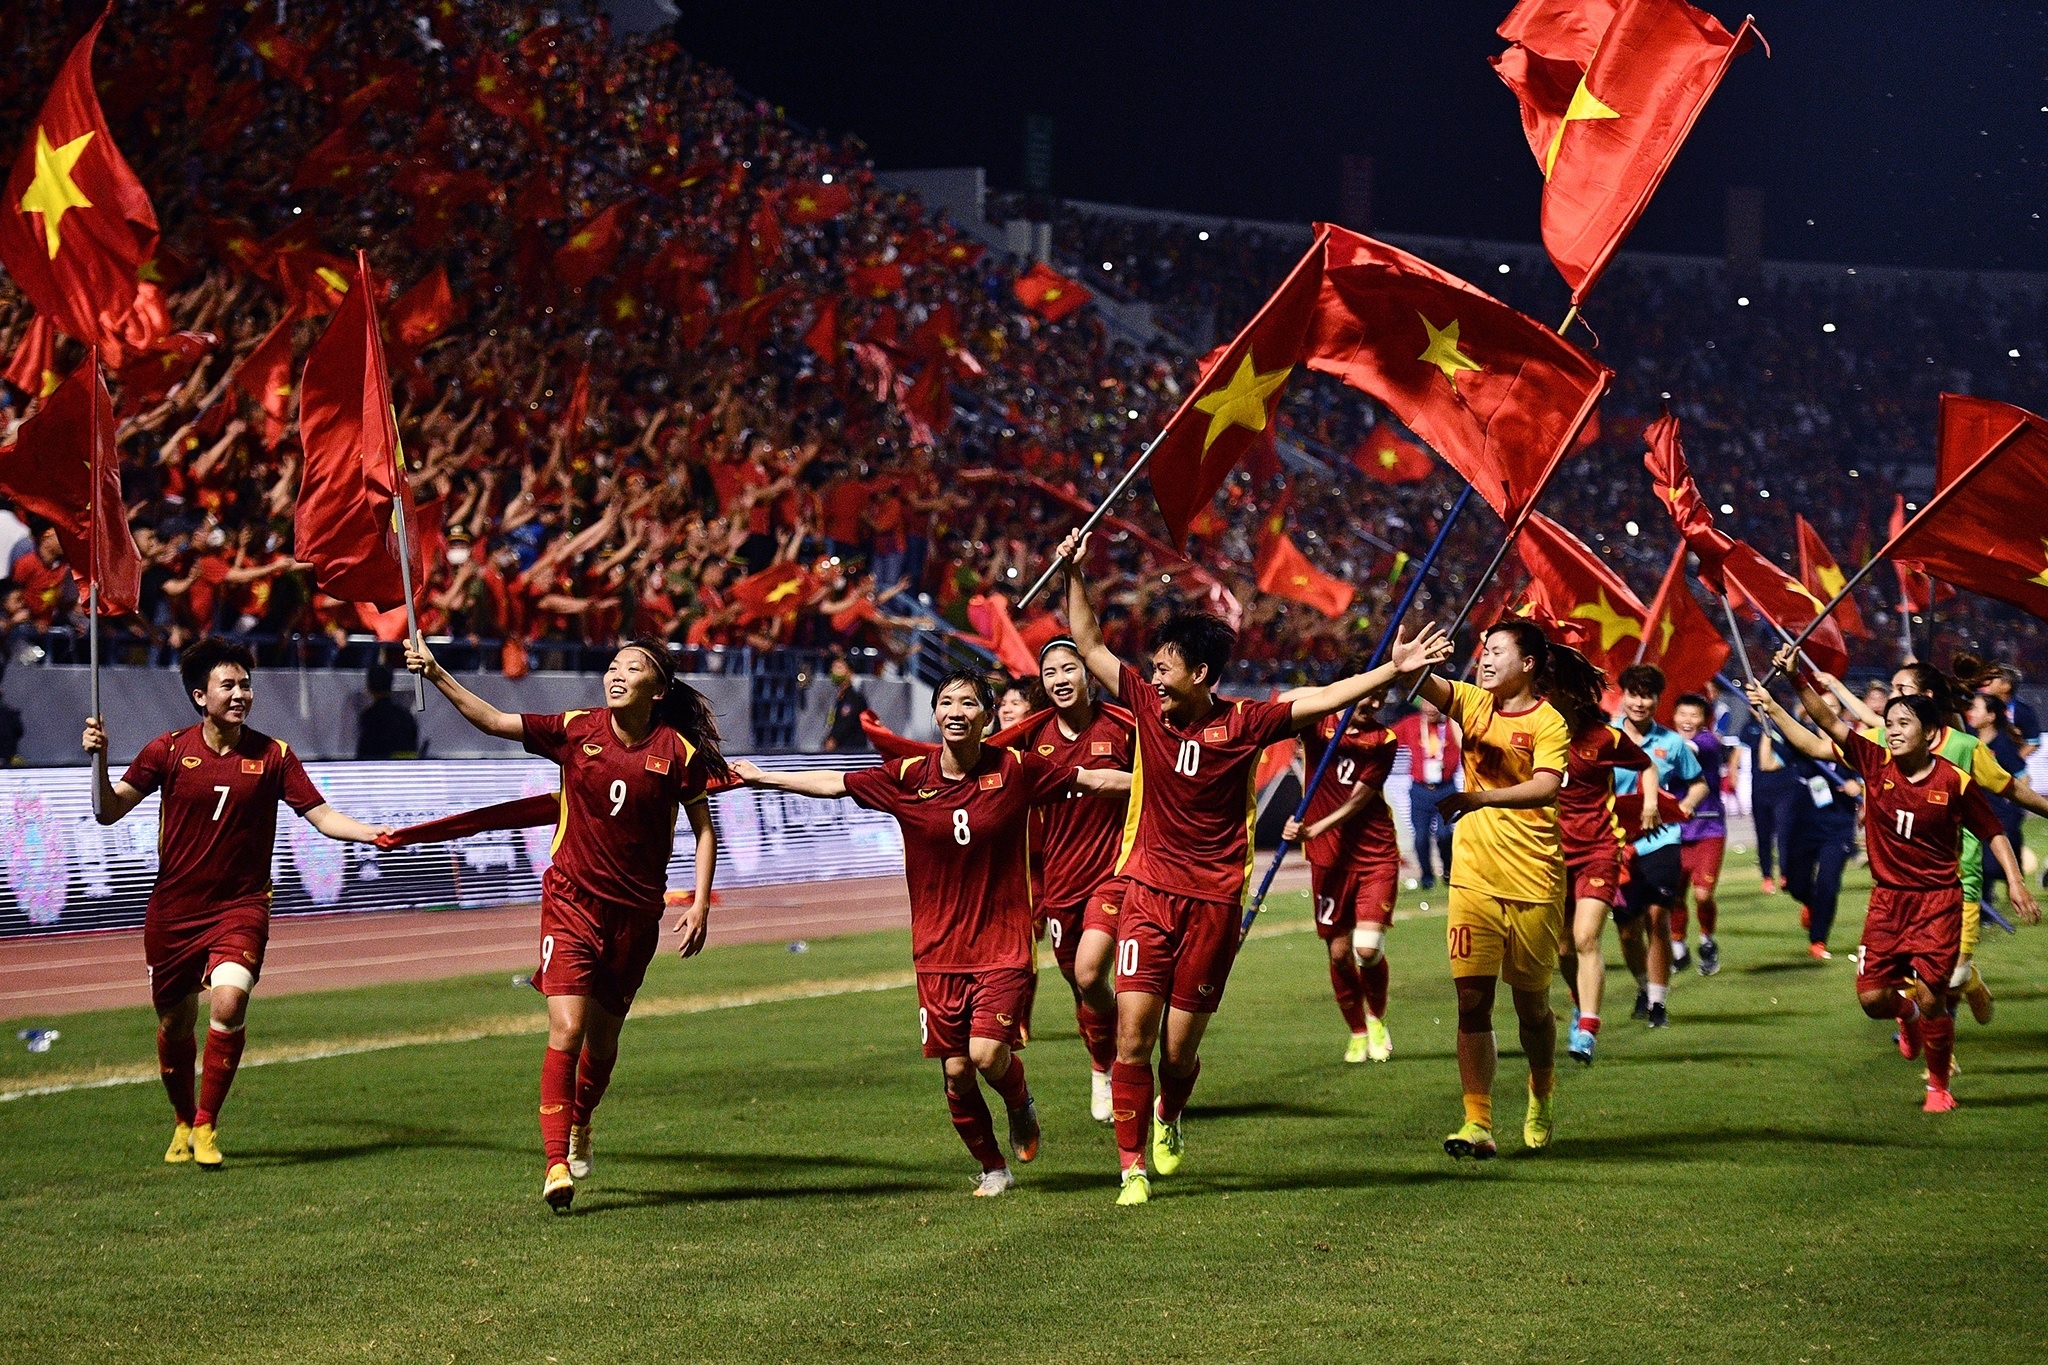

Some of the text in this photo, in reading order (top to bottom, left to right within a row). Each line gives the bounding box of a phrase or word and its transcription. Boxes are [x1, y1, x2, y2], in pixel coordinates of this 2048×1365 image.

[1175, 739, 1200, 776] 10
[212, 786, 231, 821] 7
[609, 779, 627, 817] 9
[953, 809, 971, 846] 8
[1896, 809, 1914, 839] 11
[1317, 895, 1335, 925] 12
[542, 935, 554, 974] 9
[1117, 939, 1139, 977] 10
[1450, 926, 1471, 959] 20
[920, 1007, 928, 1045] 8
